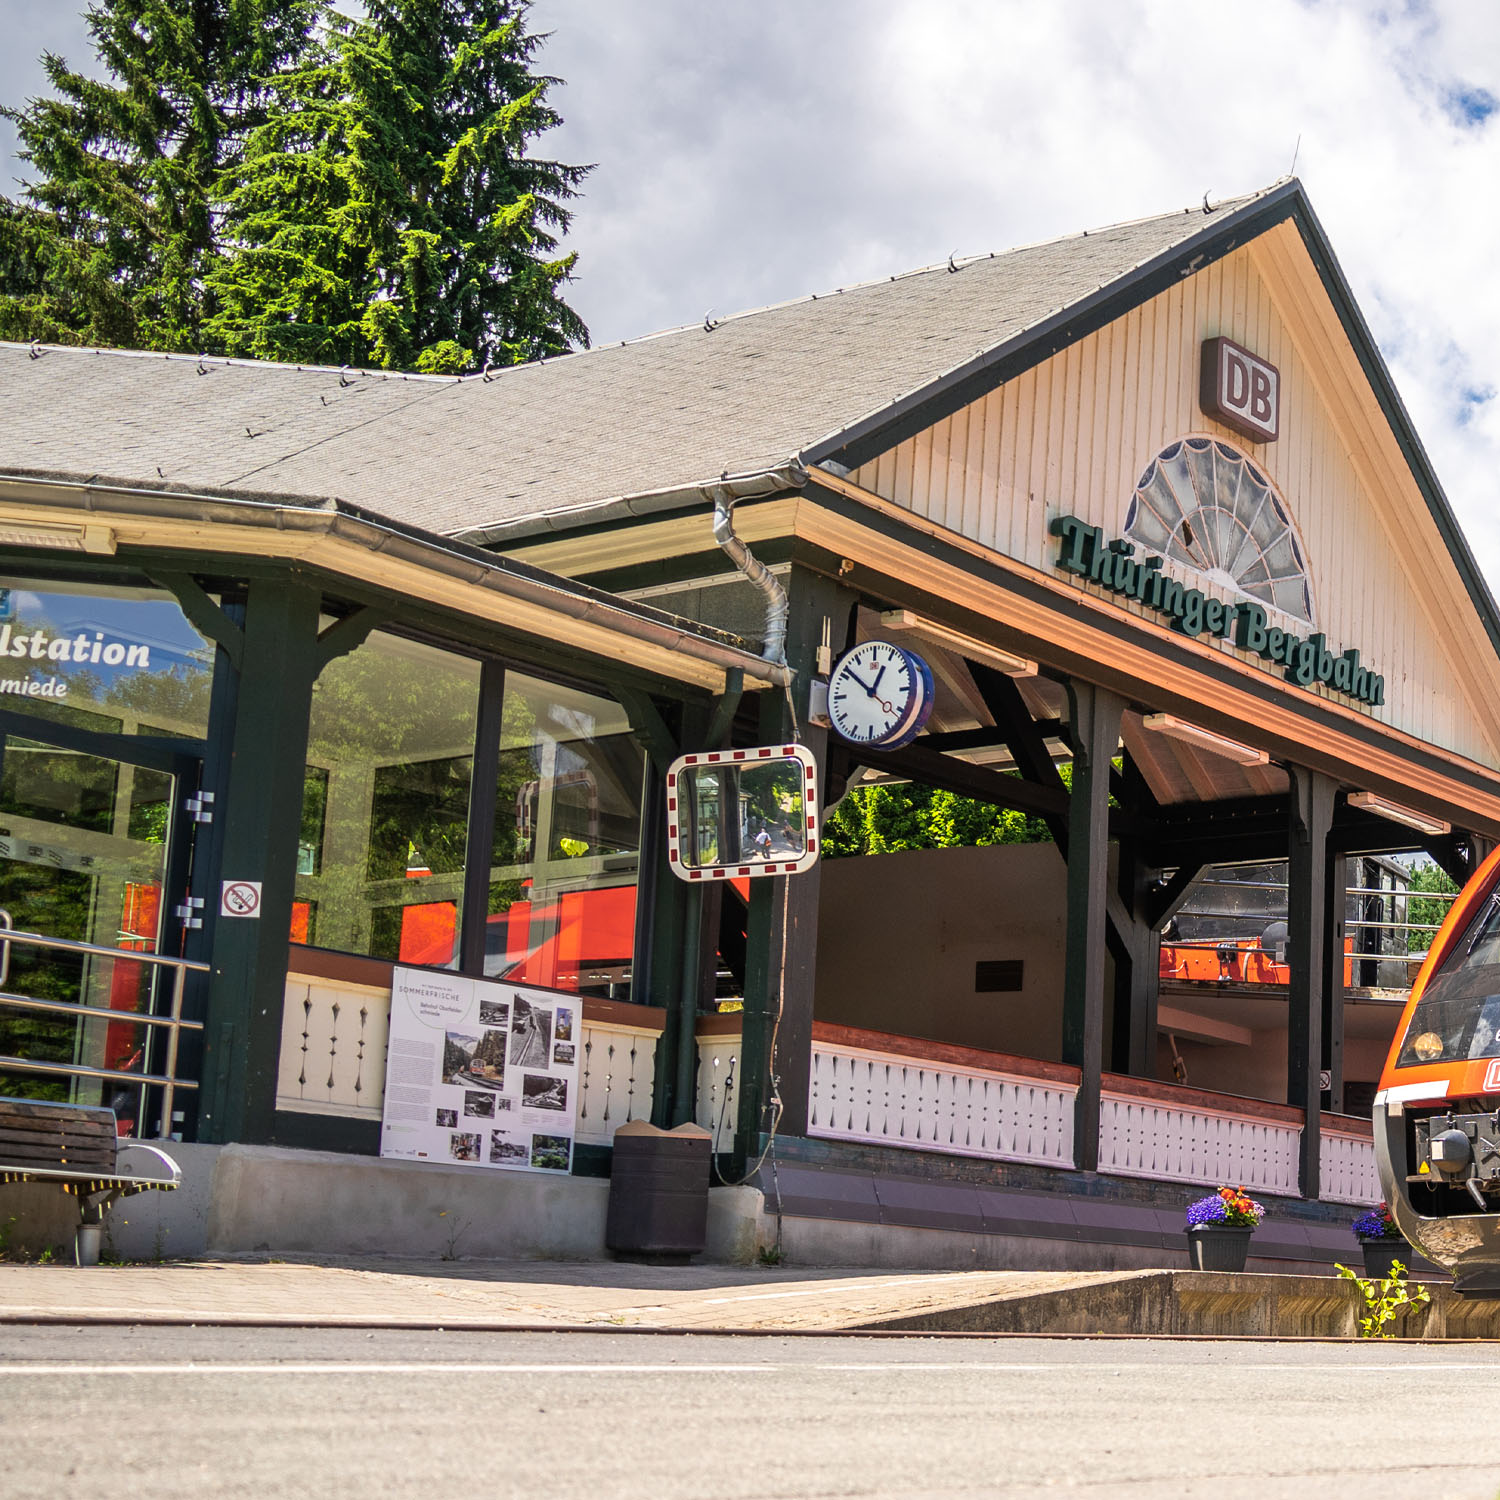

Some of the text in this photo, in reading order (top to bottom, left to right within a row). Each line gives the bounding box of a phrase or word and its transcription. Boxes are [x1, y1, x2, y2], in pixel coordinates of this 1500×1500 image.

[1226, 350, 1272, 424] DB
[1050, 514, 1385, 706] Thüringer Bergbahn
[0, 623, 150, 667] lstation
[0, 675, 68, 697] miede
